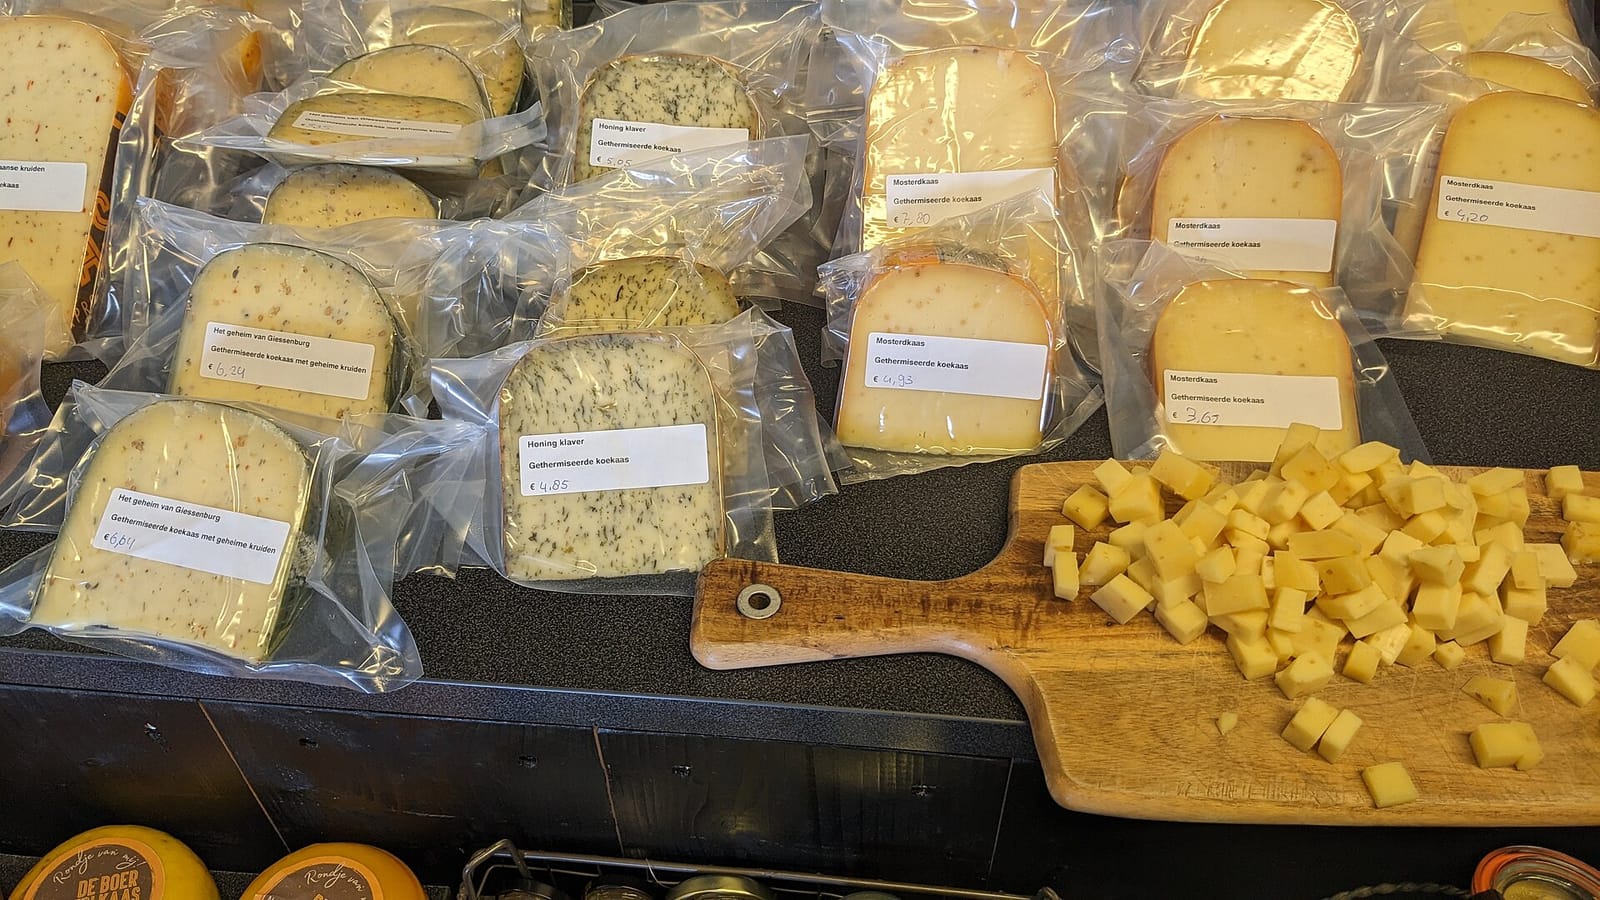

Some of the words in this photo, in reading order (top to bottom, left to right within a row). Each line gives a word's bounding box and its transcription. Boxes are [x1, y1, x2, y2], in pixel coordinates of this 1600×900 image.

[599, 123, 623, 132] Honing
[625, 125, 646, 133] klaver
[598, 139, 652, 150] Gethermiseerde
[653, 144, 681, 153] koekaas
[1447, 180, 1494, 190] Mosterdkaas
[893, 197, 950, 205] Gethermiseerde
[1446, 195, 1504, 207] Gethermiseerde
[1506, 201, 1536, 211] koekaas
[1175, 222, 1221, 230] Mosterdkaas
[1231, 240, 1261, 248] koekaas
[213, 327, 225, 335] Het
[226, 329, 252, 339] geheim
[267, 335, 310, 347] Giessenburg
[876, 337, 925, 347] Mosterdkaas
[211, 345, 265, 359] Gethermiseerde
[266, 354, 294, 364] koekaas
[295, 357, 308, 365] met
[309, 359, 339, 370] geheime
[340, 364, 367, 374] kruiden
[874, 356, 935, 367] Gethermiseerde
[937, 361, 969, 370] koekaas
[873, 375, 878, 383] €
[1170, 375, 1218, 384] Mosterdkaas
[1171, 393, 1231, 403] Gethermiseerde
[1233, 395, 1265, 404] koekaas
[527, 441, 558, 449] Honing
[529, 459, 594, 470] Gethermiseerde
[596, 456, 630, 465] koekaas
[530, 482, 536, 491] €
[540, 480, 569, 492] 4,85
[118, 494, 132, 503] Het
[132, 497, 160, 509] geheim
[161, 502, 174, 512] van
[175, 506, 221, 522] Giessenburg
[111, 513, 169, 532] Gethermiseerde
[169, 527, 200, 539] koekaas
[201, 533, 216, 542] met
[216, 536, 248, 549] geheime
[249, 543, 276, 554] kruiden
[53, 850, 94, 884] Rondje
[98, 849, 119, 857] van
[77, 878, 99, 898] DE
[99, 869, 139, 894] BOER
[304, 863, 346, 888] Rondje
[348, 876, 365, 891] van
